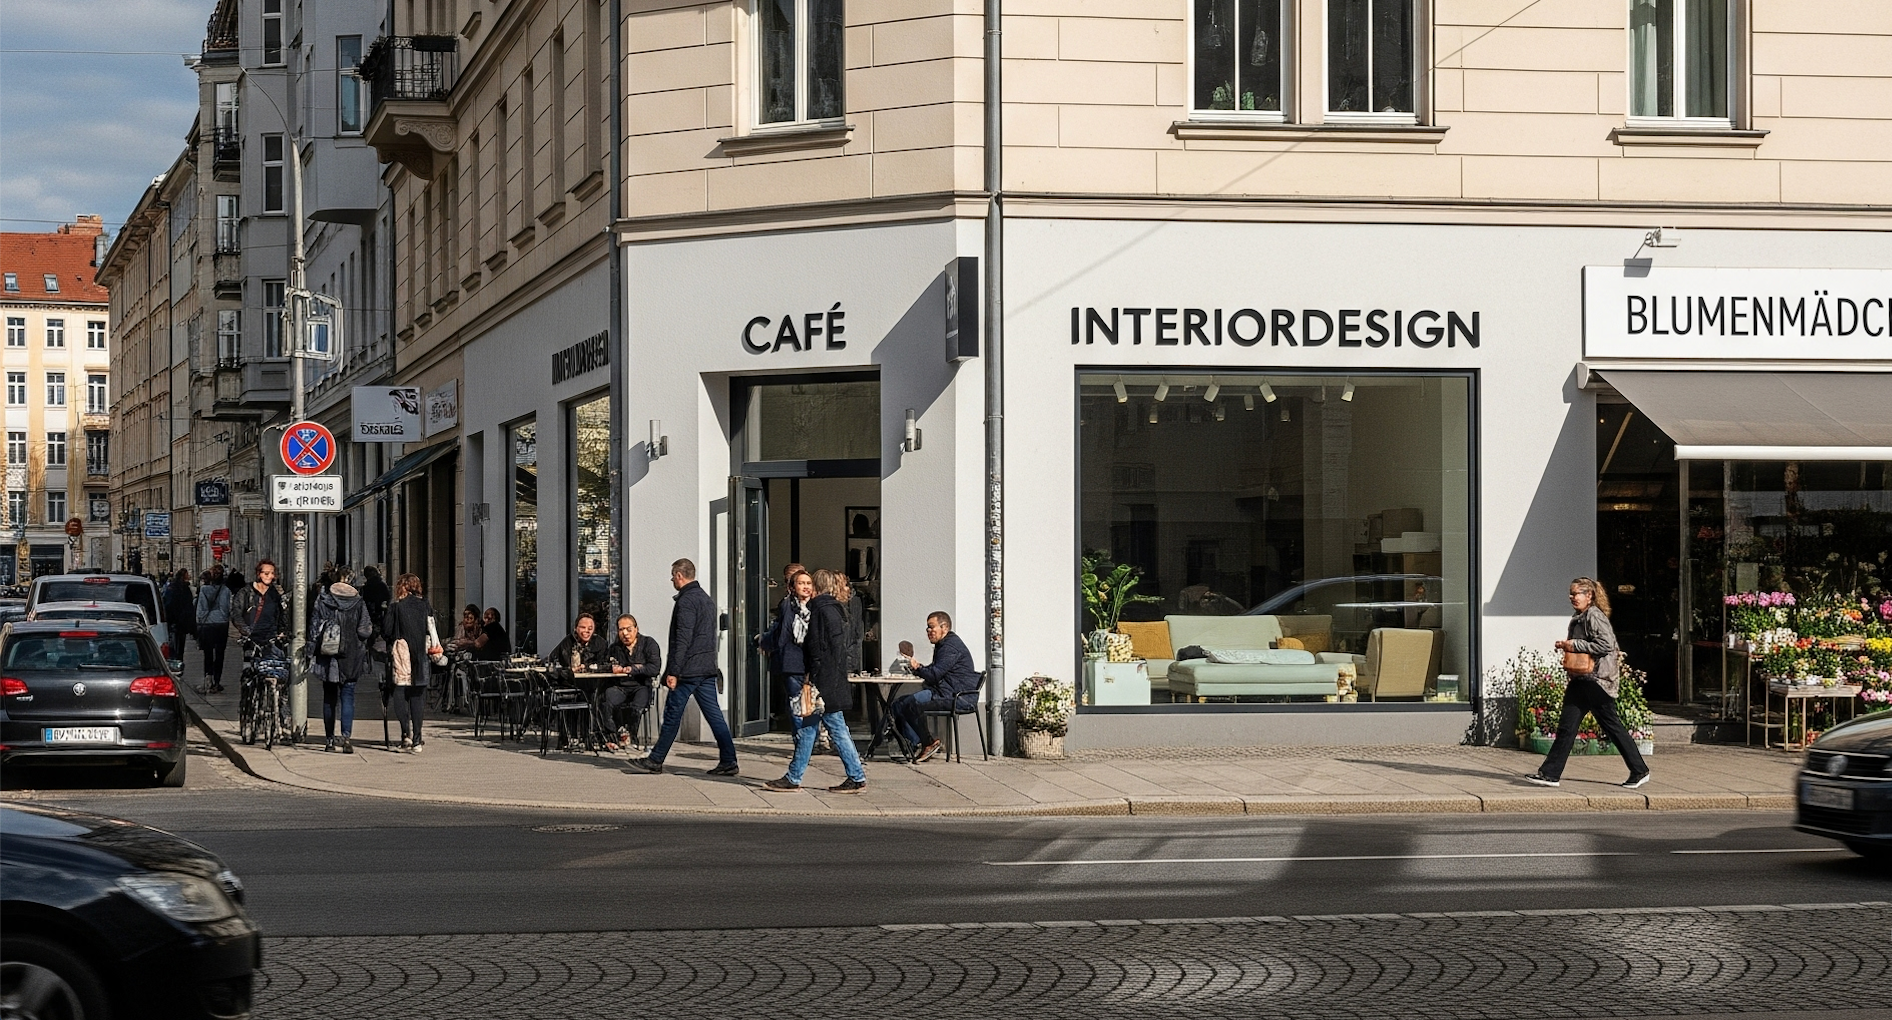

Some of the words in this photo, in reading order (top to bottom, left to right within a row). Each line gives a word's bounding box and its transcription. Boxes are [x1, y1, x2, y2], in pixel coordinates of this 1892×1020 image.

[742, 301, 846, 354] CAFÉ
[1071, 306, 1480, 349] INTERIORDESIGN
[1627, 290, 1892, 337] BLUMENMÄDC
